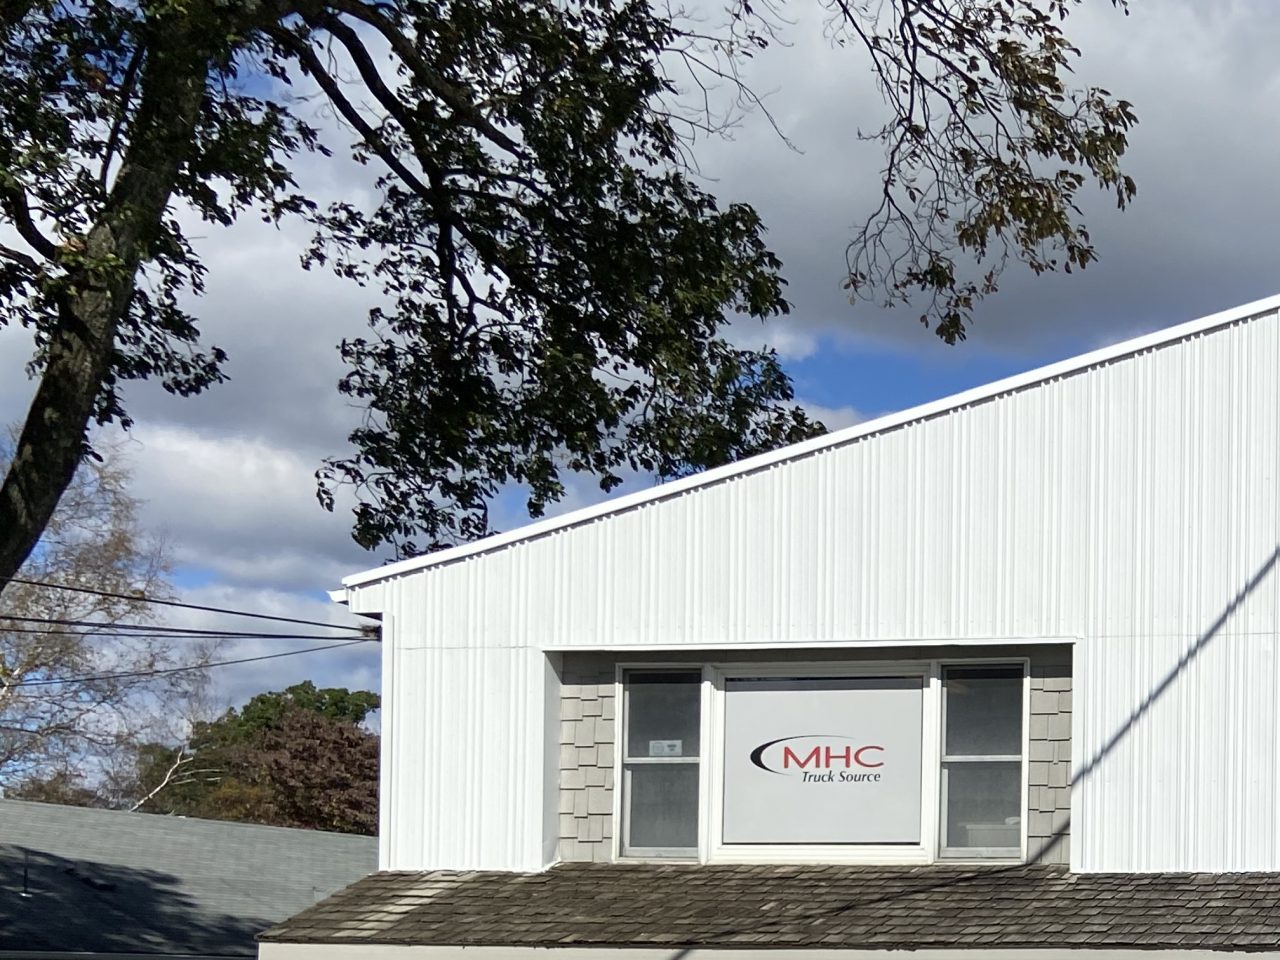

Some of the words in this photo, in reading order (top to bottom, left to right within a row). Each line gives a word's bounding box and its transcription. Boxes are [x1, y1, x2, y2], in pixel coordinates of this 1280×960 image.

[783, 745, 885, 769] MHC
[802, 770, 836, 783] Truck
[838, 770, 881, 783] Source
